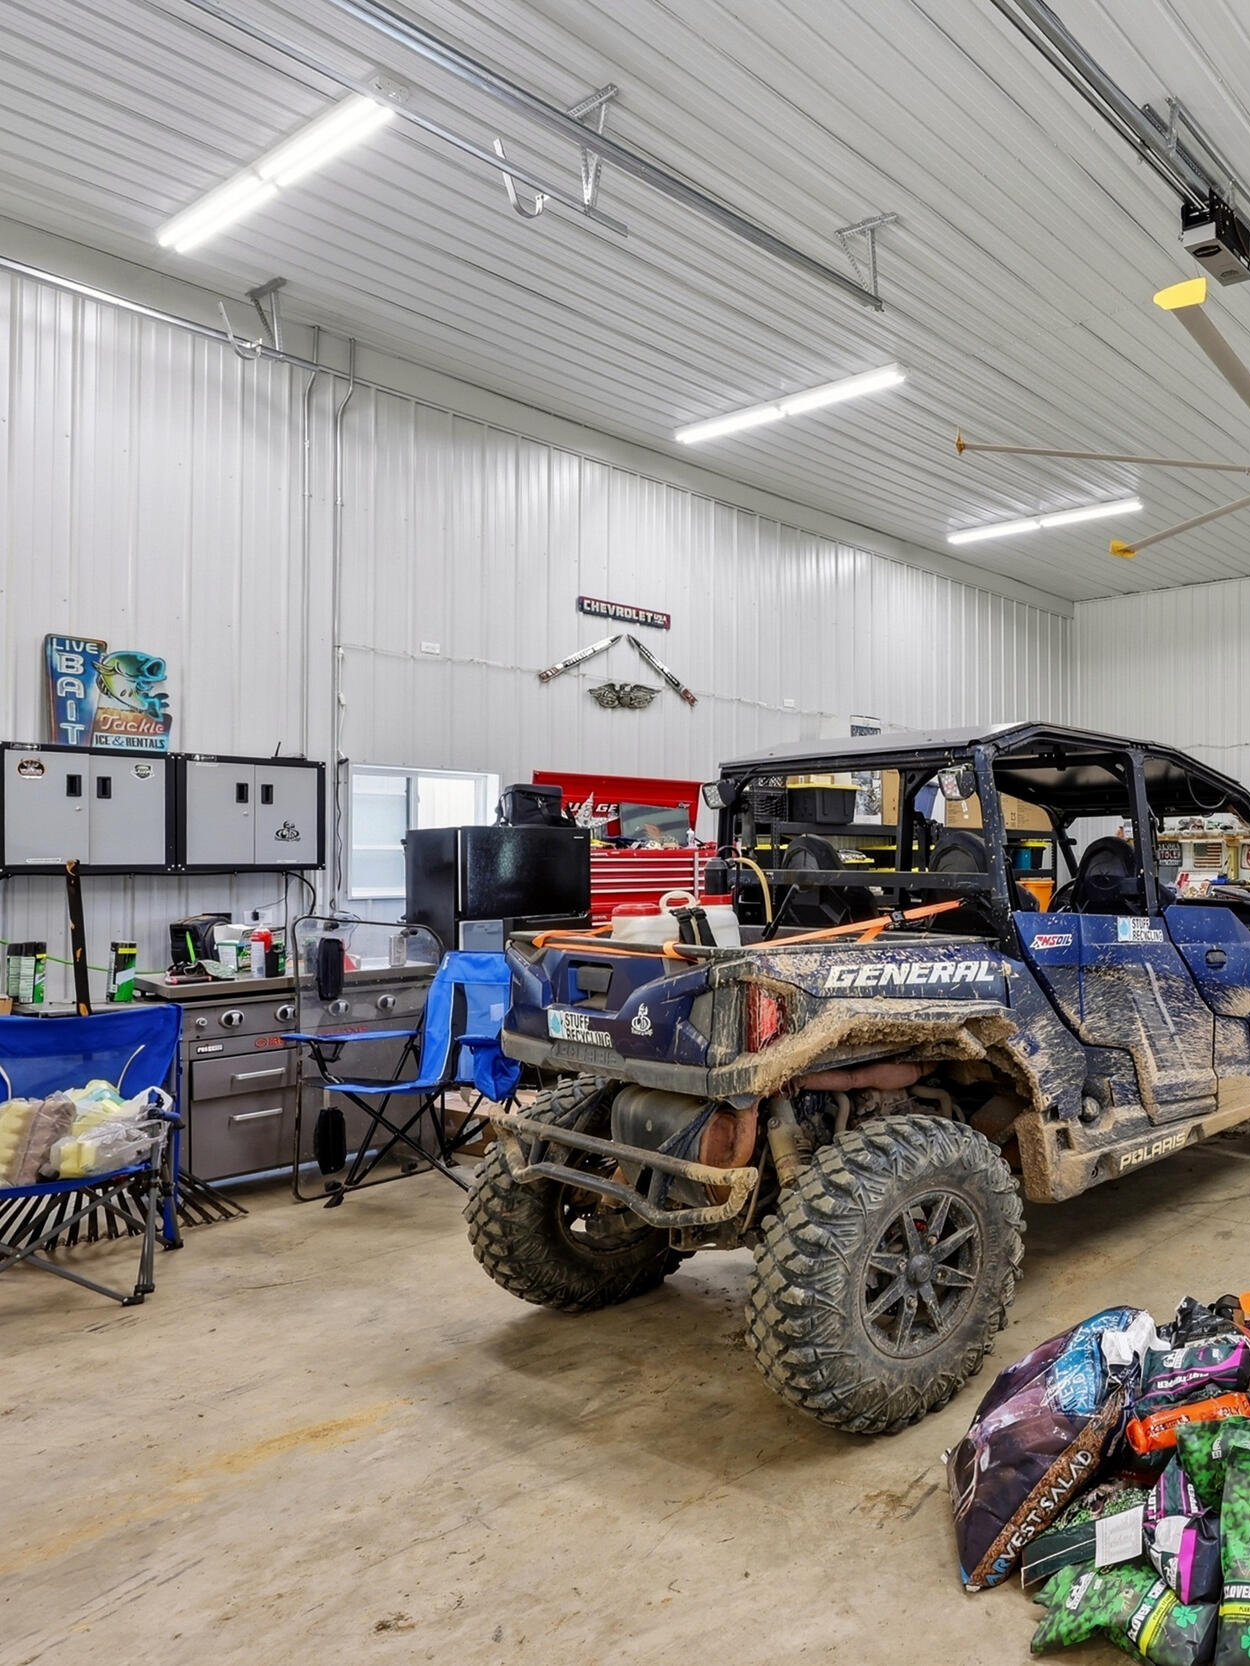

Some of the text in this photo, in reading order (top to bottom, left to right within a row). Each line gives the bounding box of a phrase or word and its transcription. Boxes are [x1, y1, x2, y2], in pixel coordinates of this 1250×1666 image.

[583, 599, 653, 623] CHEVROLET
[52, 638, 99, 655] LIVE
[56, 651, 86, 745] BAIT
[100, 714, 166, 734] Tackle
[95, 734, 166, 749] ICE & RENTALS
[1131, 918, 1149, 930] STUFF
[1032, 934, 1072, 948] AMSOIL
[1132, 930, 1163, 941] RECYCLING
[824, 961, 994, 988] GENERAL
[564, 1012, 590, 1030] STUFF
[566, 1028, 613, 1048] RECYCLING
[1119, 1132, 1187, 1171] POLARIS
[986, 1509, 1042, 1586] ARVEST
[1040, 1450, 1093, 1510] SALAD
